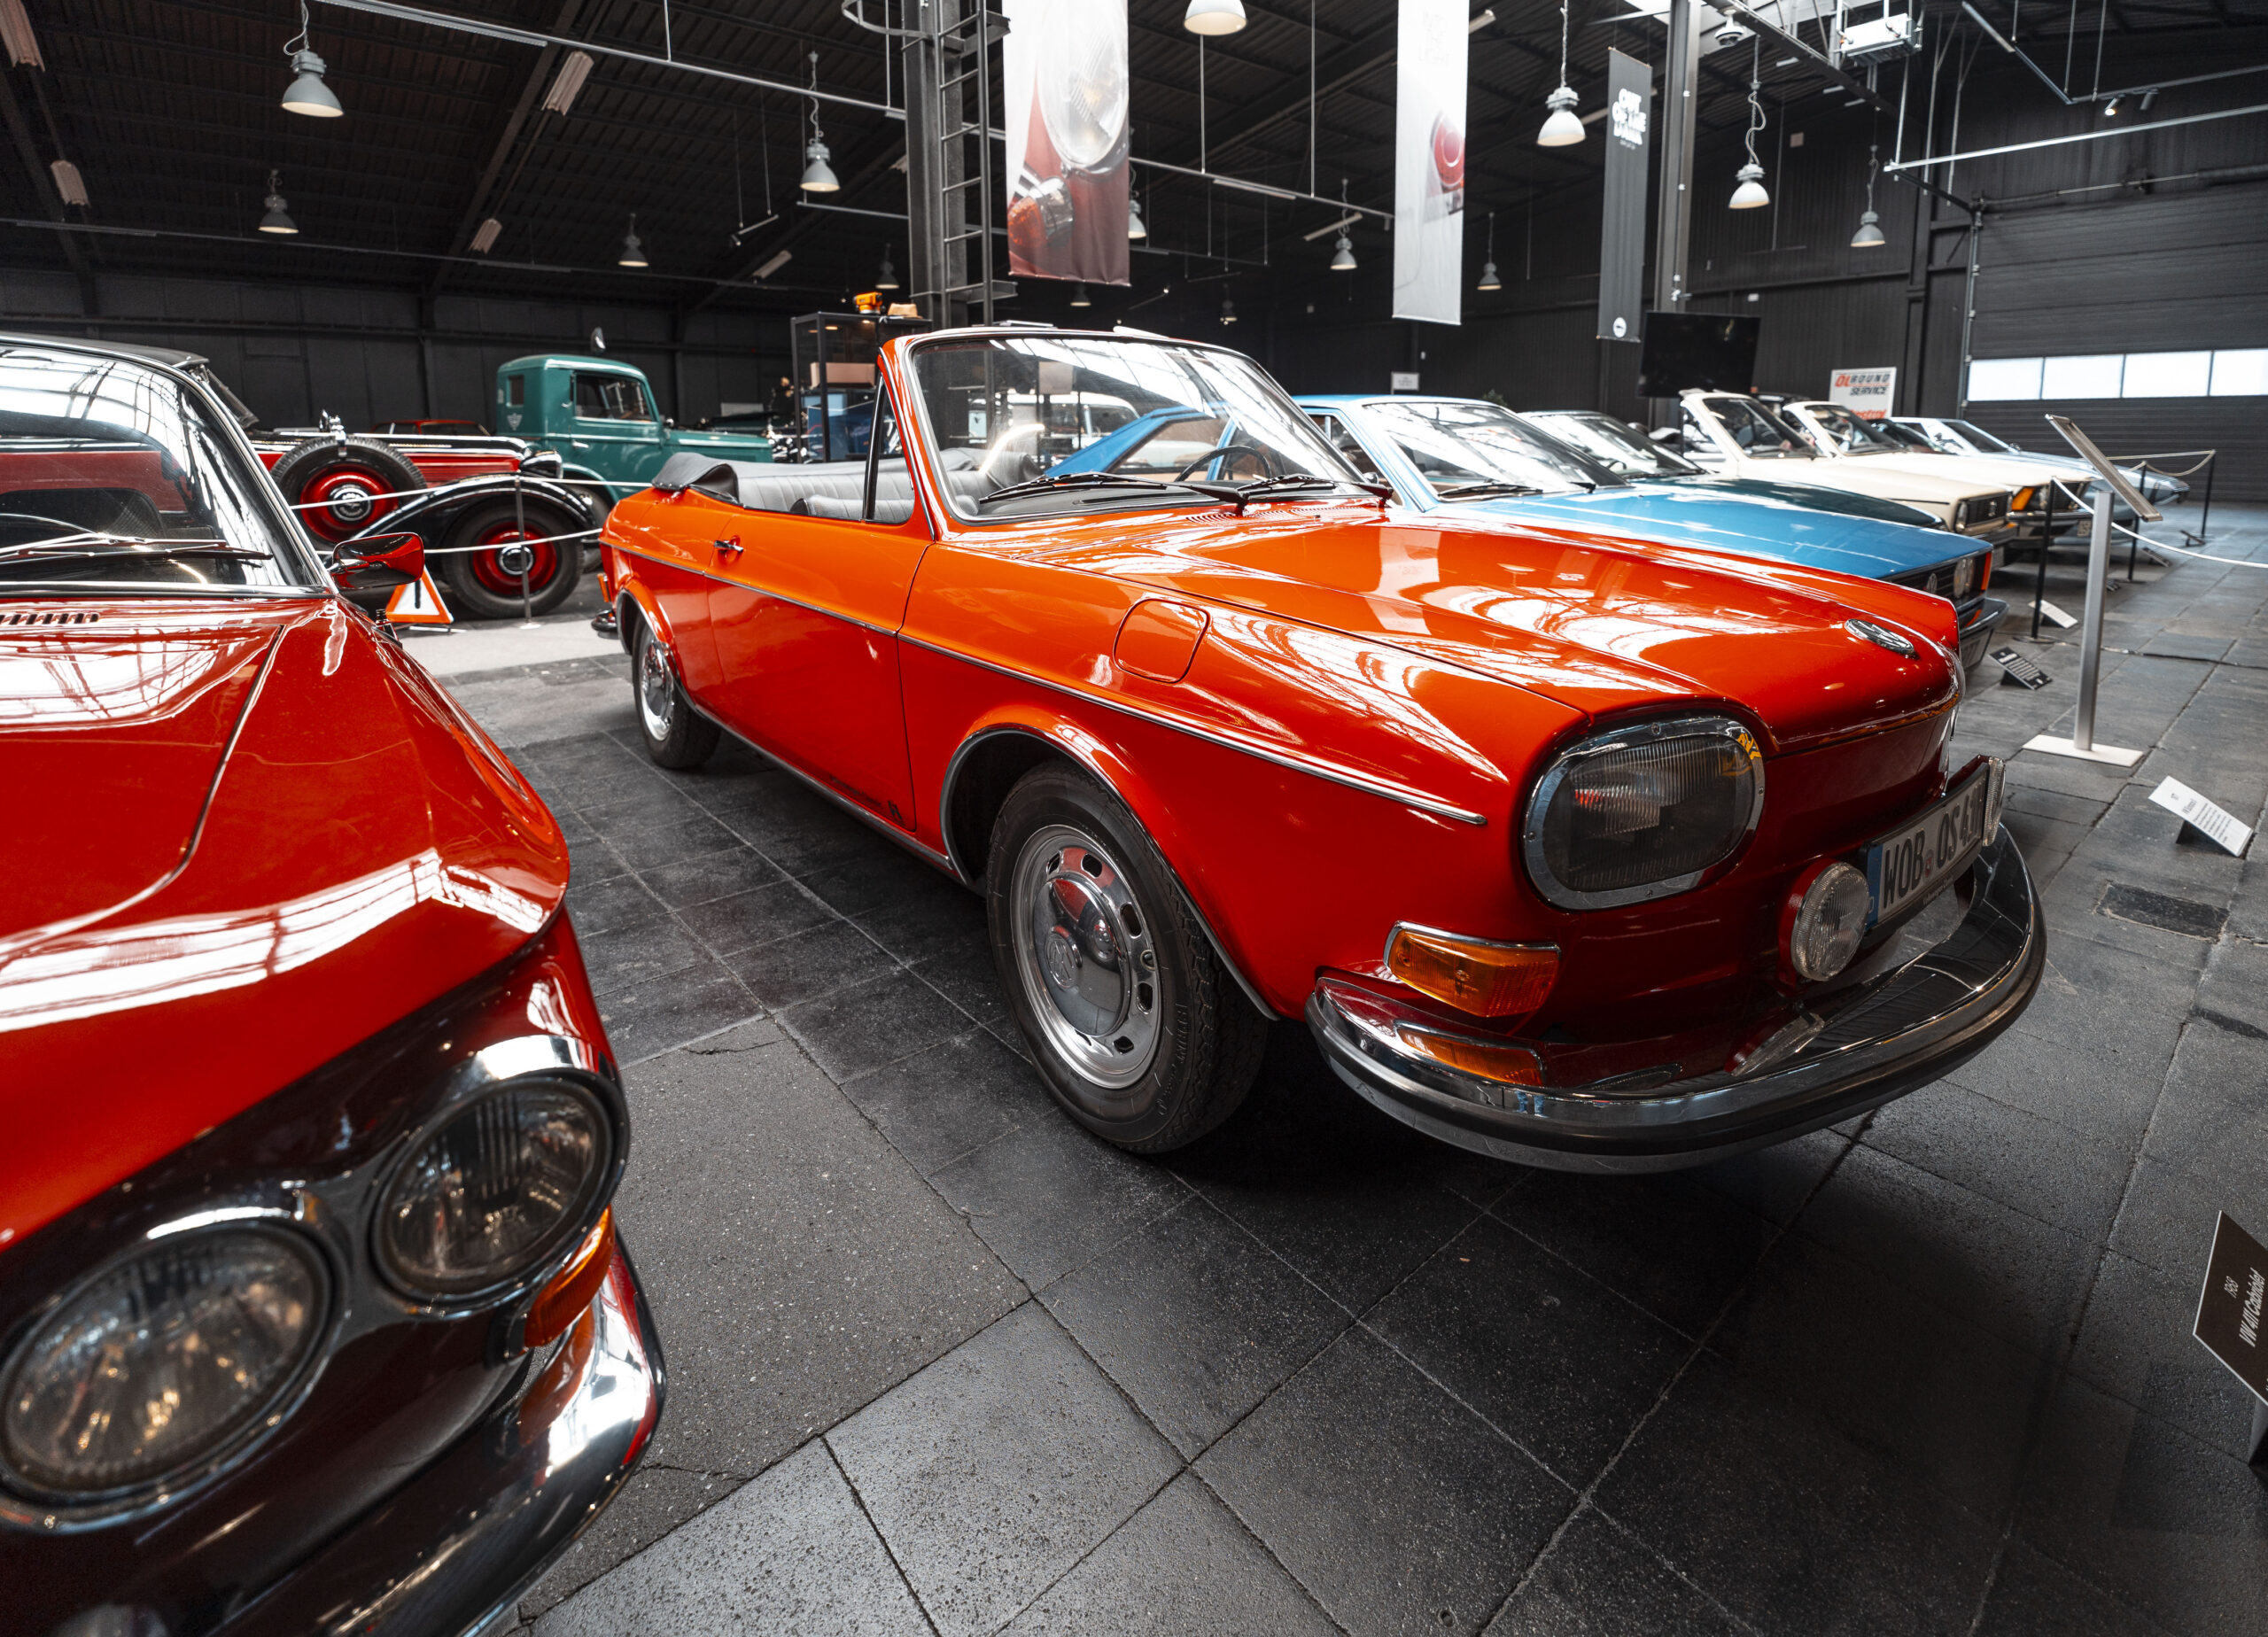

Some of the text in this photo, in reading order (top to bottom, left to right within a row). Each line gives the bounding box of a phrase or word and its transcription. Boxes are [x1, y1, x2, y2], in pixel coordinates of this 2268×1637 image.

[1850, 386, 1887, 396] SERVICE
[1884, 826, 1925, 909] WOB
[2224, 1276, 2239, 1299] 1968
[2239, 1267, 2265, 1347] VW 411 Cabriolet
